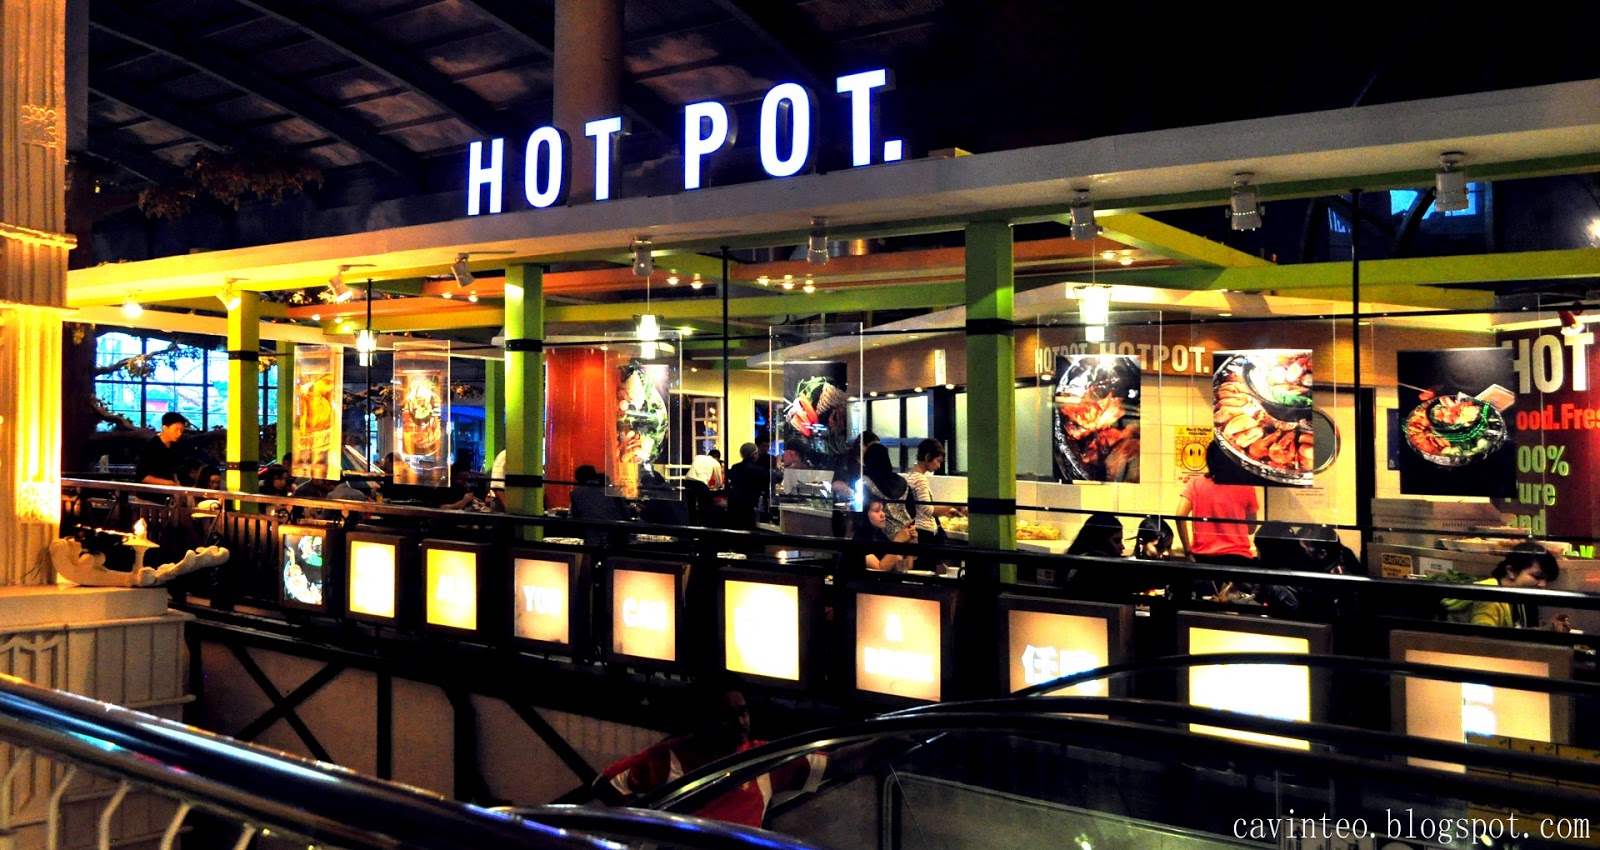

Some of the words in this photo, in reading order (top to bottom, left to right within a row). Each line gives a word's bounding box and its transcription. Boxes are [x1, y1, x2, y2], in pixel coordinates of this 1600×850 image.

[467, 116, 622, 216] HOT
[684, 69, 903, 190] POT.
[1502, 332, 1595, 394] HOT
[1518, 445, 1569, 476] 00%
[1505, 480, 1556, 506] ure
